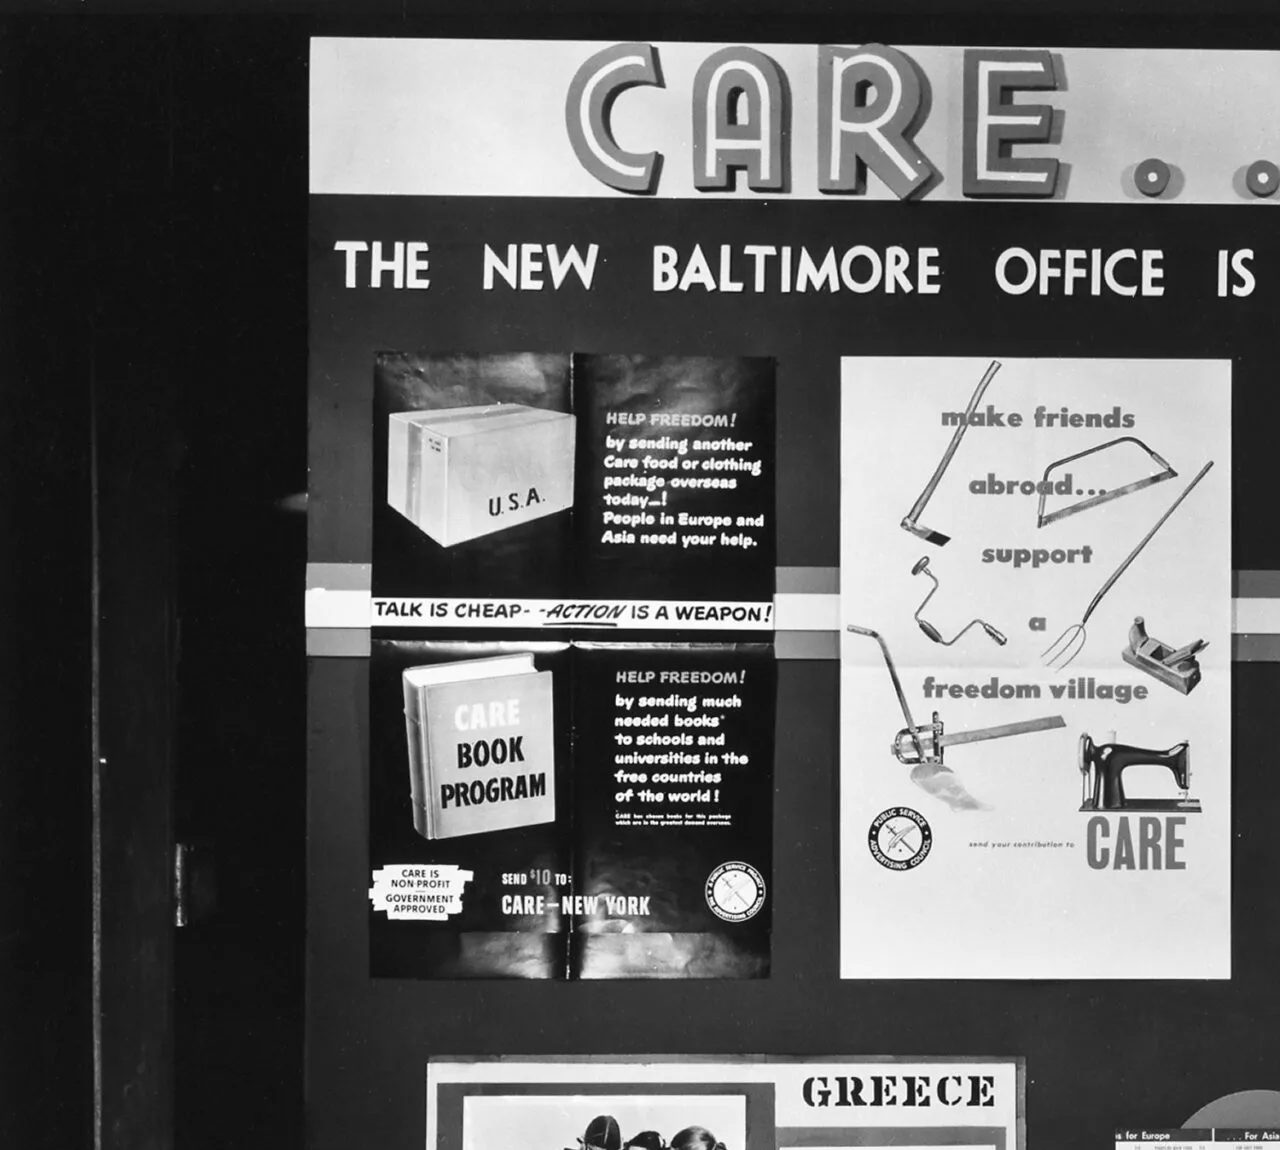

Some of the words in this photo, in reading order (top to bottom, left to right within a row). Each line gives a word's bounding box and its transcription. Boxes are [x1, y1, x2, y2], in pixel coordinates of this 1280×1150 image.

[566, 41, 1060, 201] CARE
[334, 241, 430, 289] THE
[483, 243, 599, 290] NEW
[653, 244, 940, 293] BALTIMORE
[995, 247, 1165, 297] OFFICE
[1218, 249, 1255, 297] IS
[606, 412, 646, 425] HELP
[649, 408, 736, 428] FREEDOM!
[940, 405, 1023, 428] make
[1034, 406, 1135, 428] friends
[489, 487, 545, 516] U.S.A.
[603, 511, 655, 528] People
[660, 512, 674, 525] in
[678, 512, 732, 529] Europe
[736, 514, 764, 527] and
[982, 545, 1093, 568] support
[374, 602, 422, 617] TALK
[430, 603, 448, 617] IS
[631, 605, 649, 620] IS
[655, 606, 669, 620] A
[675, 605, 772, 622] WEAPON!
[1029, 617, 1046, 631] a
[923, 676, 1041, 699] freedom
[1049, 677, 1149, 704] village
[454, 699, 521, 731] CARE
[457, 736, 525, 769] BOOK
[615, 751, 700, 764] universities
[704, 752, 718, 764] in
[721, 752, 749, 764] the
[441, 772, 546, 809] PROGRAM
[1087, 816, 1186, 870] CARE
[501, 872, 527, 885] SEND
[385, 894, 453, 903] GOVERNMENT
[393, 904, 445, 914] APPROVED
[803, 1076, 994, 1107] GREECE
[1126, 1131, 1138, 1140] for
[1141, 1132, 1170, 1142] Europe
[1262, 1132, 1280, 1140] Asia
